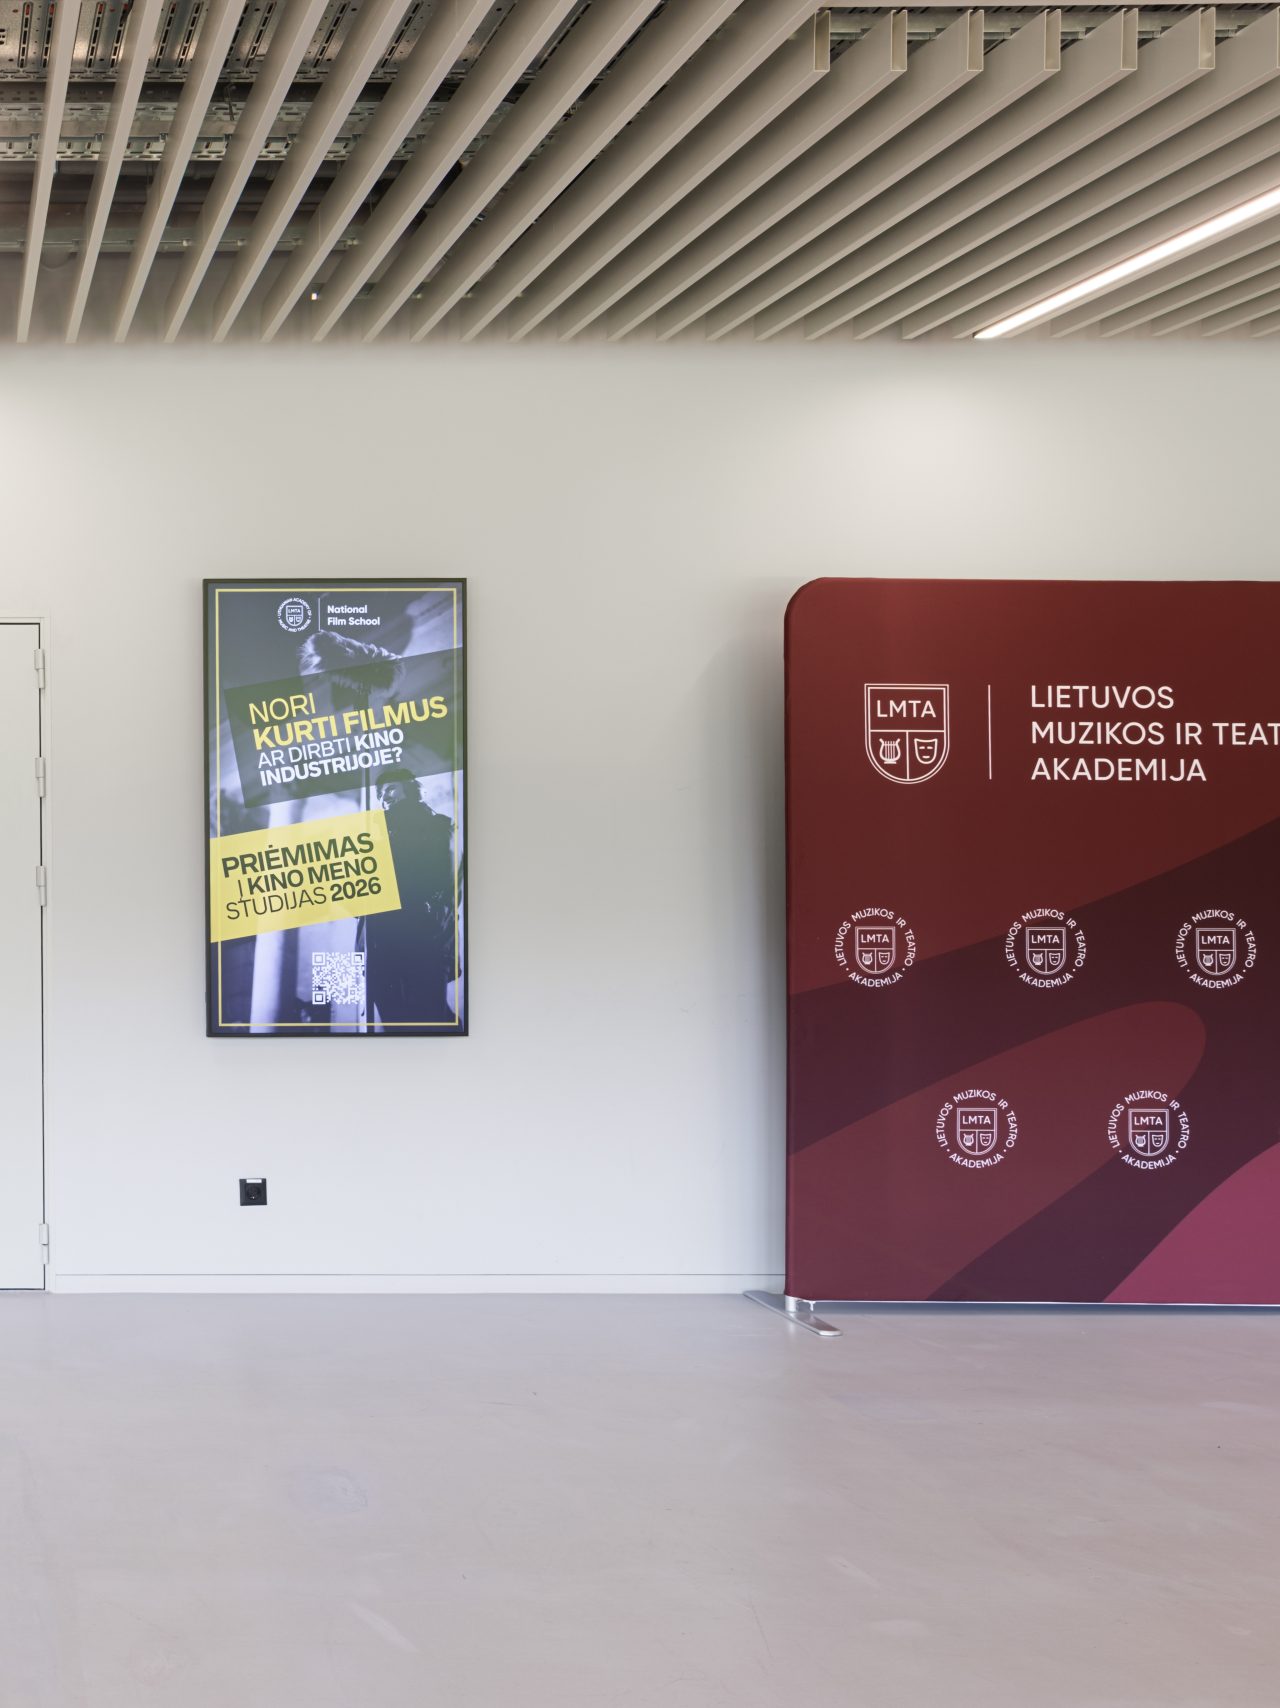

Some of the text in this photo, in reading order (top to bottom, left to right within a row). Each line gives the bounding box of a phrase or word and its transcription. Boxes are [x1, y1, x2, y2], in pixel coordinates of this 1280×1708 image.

[328, 605, 368, 614] National
[328, 617, 380, 626] Film School
[249, 692, 316, 724] NORI
[877, 700, 937, 718] LMTA
[1031, 685, 1174, 709] LIETUVOS
[253, 696, 448, 750] KURTI FILMUS
[1031, 722, 1280, 746] MUZIKOS IR TEAT
[258, 728, 404, 768] AR DIRBTI KINO
[260, 747, 403, 787] INDUSTRIJOJE?
[1031, 758, 1206, 782] AKADEMIJA
[221, 833, 374, 878] PRIĖMIMAS
[248, 869, 304, 895] KINO
[308, 856, 378, 884] MENO
[226, 877, 382, 920] STUDIJAS 2026
[835, 908, 916, 966] LIETUVOS MUZIKOS IR TEATRO
[861, 934, 890, 943] LMTA
[1005, 908, 1086, 967] LIETUVOS MUZIKOS IR TEATRO
[1031, 935, 1060, 943] LMTA
[1176, 909, 1256, 968] LIETUVOS MUZIKOS IR TEATRO
[1201, 936, 1230, 944] LMTA
[848, 972, 903, 987] AKADEMIJA
[1019, 972, 1073, 988] AKADEMIJA
[1189, 973, 1244, 988] AKADEMIJA
[936, 1089, 1018, 1148] LIETUVOS MUZIKOS IR TEATRO
[962, 1116, 991, 1124] LMTA
[1108, 1090, 1190, 1148] LIETUVOS MUZIKOS IR TEATRO
[1134, 1117, 1163, 1125] LMTA
[949, 1153, 1004, 1168] AKADEMIJA
[1121, 1154, 1176, 1169] AKADEMIJA
